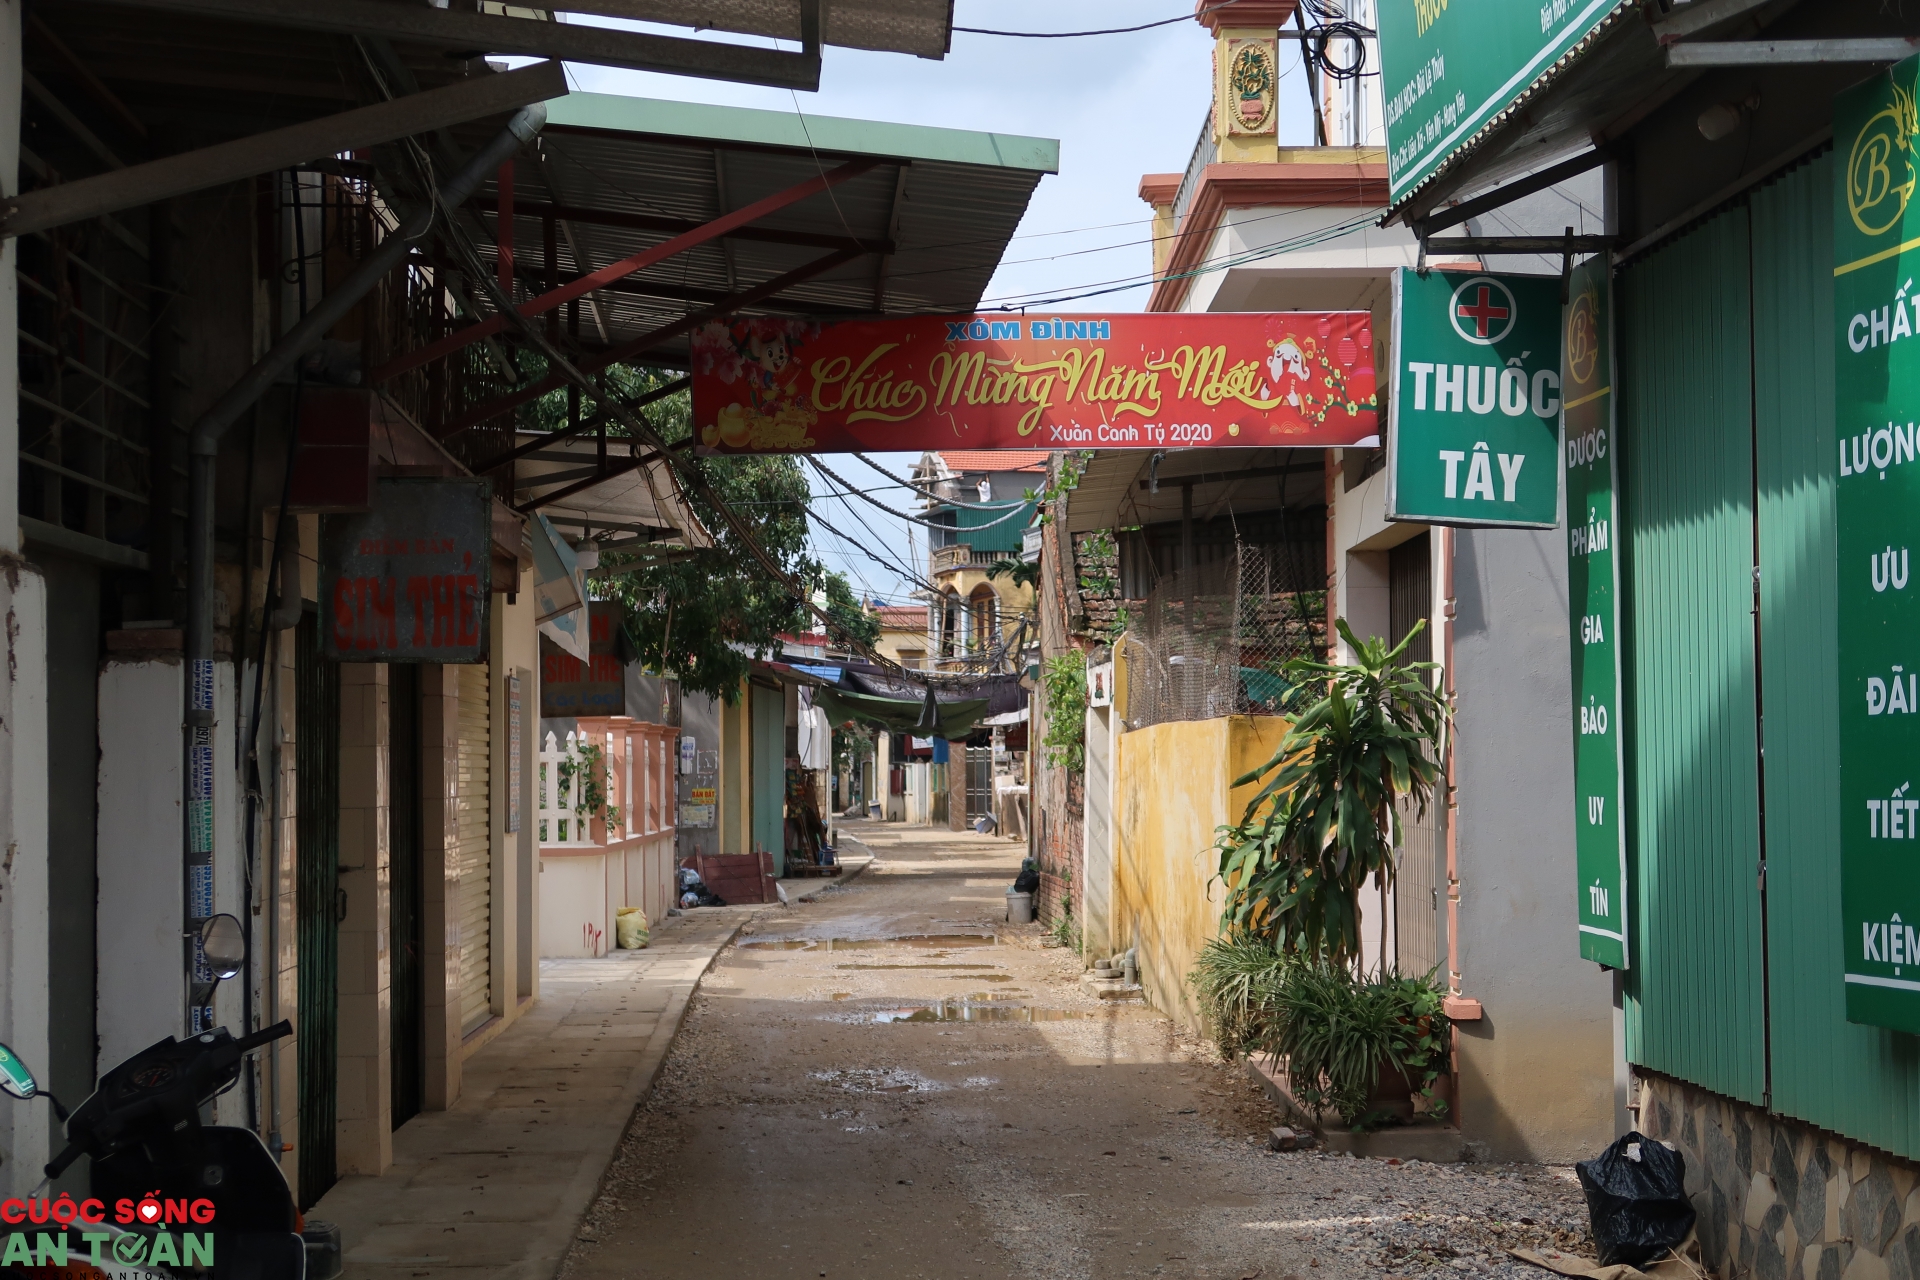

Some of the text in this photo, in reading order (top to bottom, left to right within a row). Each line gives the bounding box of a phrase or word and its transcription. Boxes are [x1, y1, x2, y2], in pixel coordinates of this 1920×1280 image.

[945, 318, 1110, 341] XÓM ĐÌNH
[811, 343, 1282, 436] Chúc Mừng Năm Mới
[1408, 351, 1560, 418] THUỐC
[1050, 423, 1092, 442] Xuân
[1098, 424, 1138, 442] Canh
[1170, 424, 1212, 442] 2020
[1568, 428, 1606, 470] DƯỢC
[1840, 422, 1920, 480] LƯỢN
[1439, 441, 1525, 502] TÂY
[1572, 507, 1608, 557] PHẨM
[1871, 546, 1908, 592] ƯU
[333, 550, 478, 650] SIM THẺ
[1580, 614, 1604, 644] GIA
[545, 655, 580, 683] SIM
[1866, 666, 1917, 716] ĐÃI
[1581, 695, 1607, 735] BẢO
[1588, 796, 1604, 825] UY
[1866, 781, 1919, 839] TIẾT
[1589, 878, 1608, 917] TÍN
[1862, 912, 1920, 976] KIỆM
